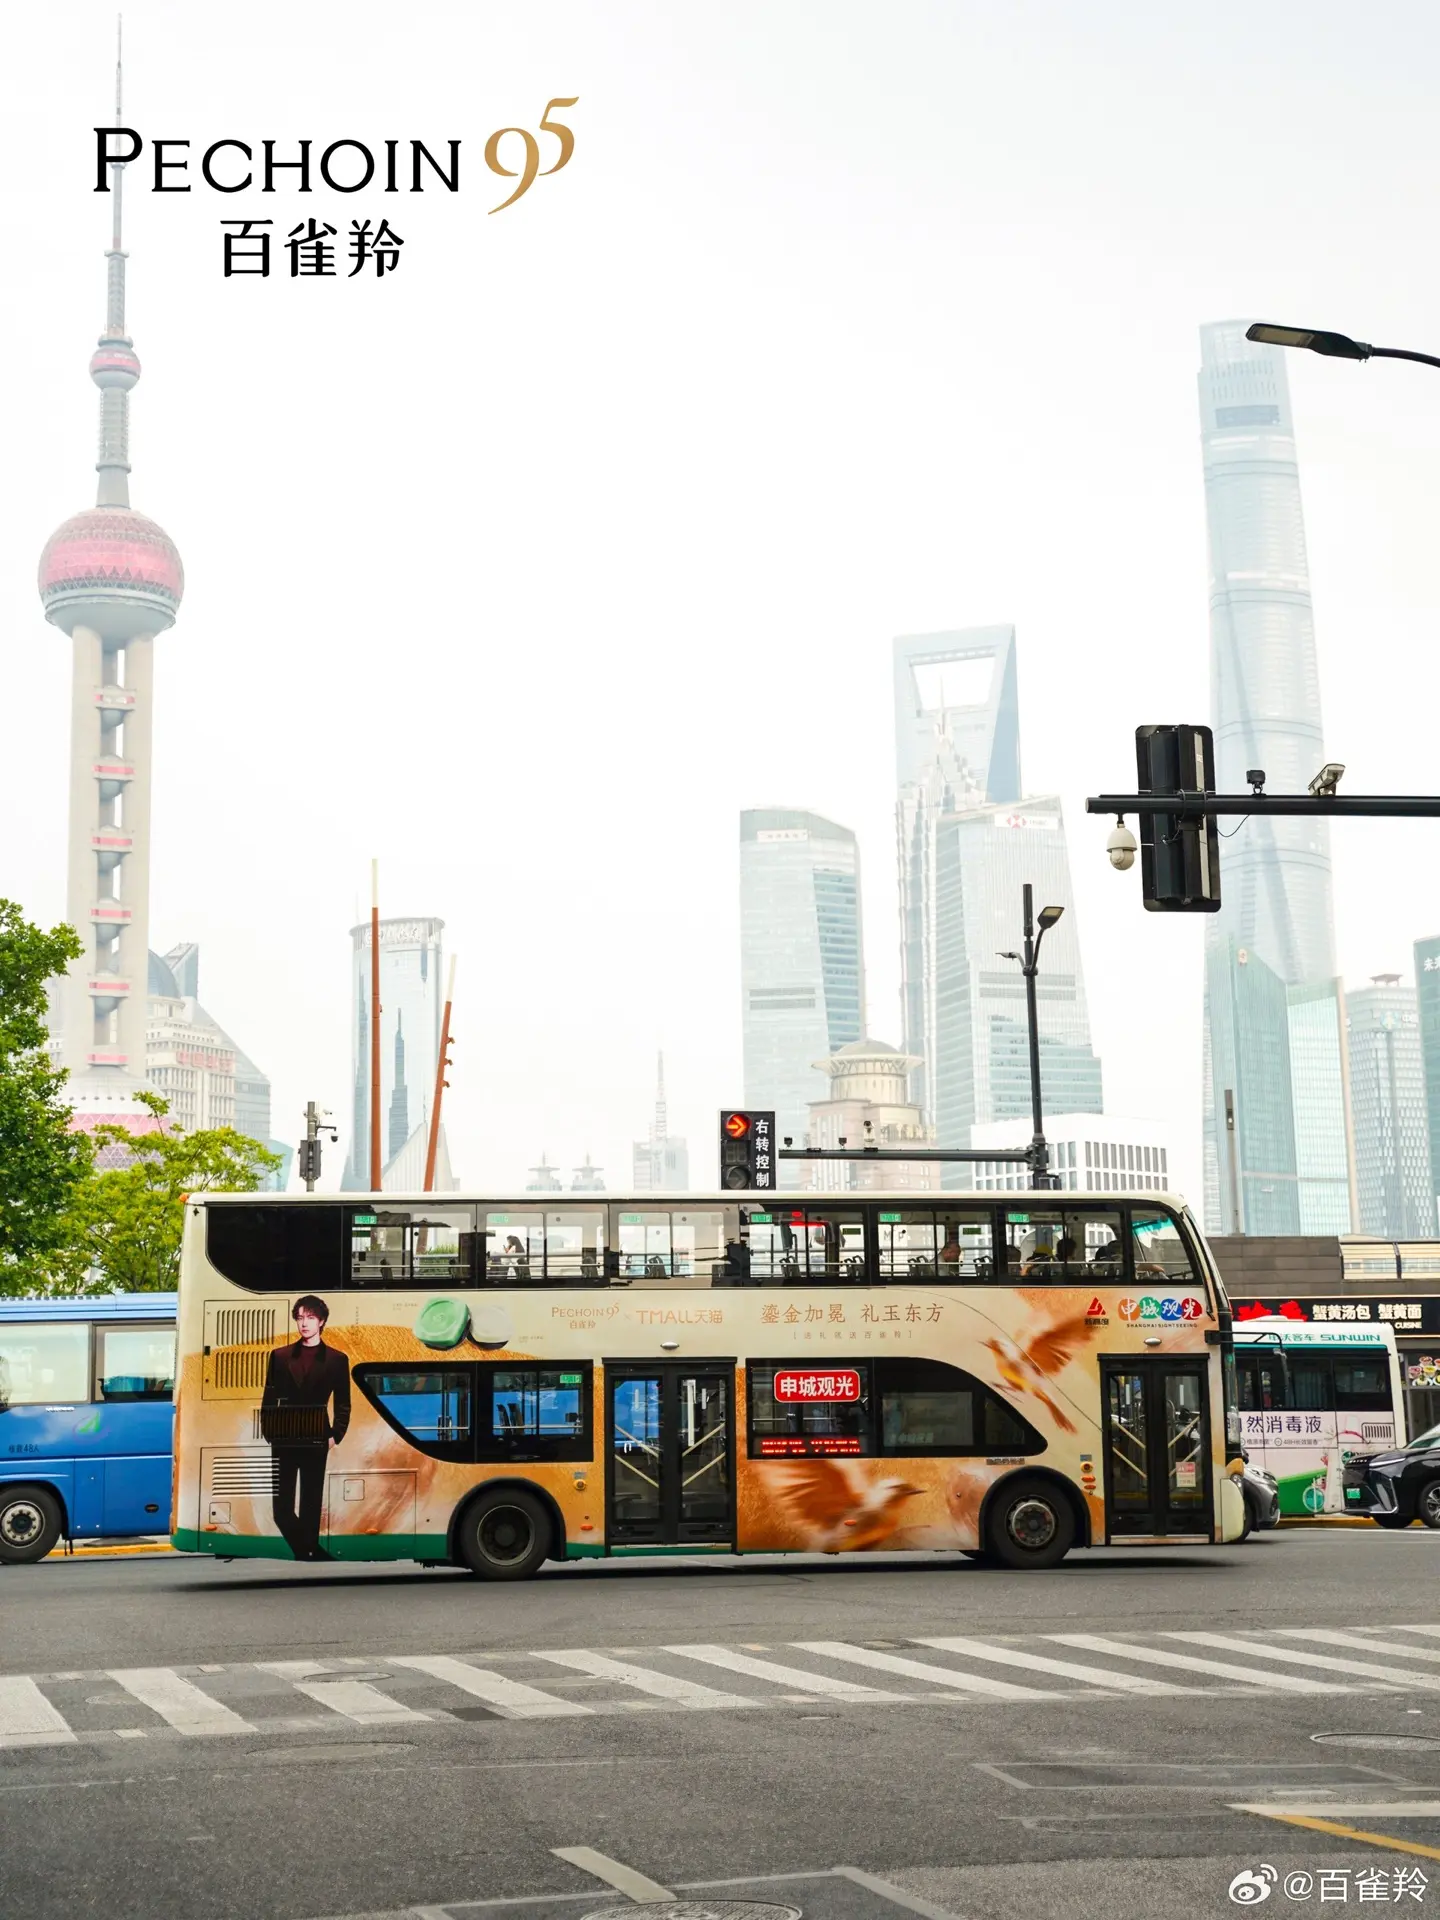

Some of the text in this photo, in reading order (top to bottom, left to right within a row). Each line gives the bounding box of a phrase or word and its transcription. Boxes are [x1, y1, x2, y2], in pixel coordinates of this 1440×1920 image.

[755, 1119, 769, 1187] 右转控制
[552, 1303, 619, 1320] PECHOIN 95
[761, 1303, 944, 1324] 鎏金加冕 礼玉东方
[1119, 1297, 1203, 1321] 申城观光
[1312, 1304, 1371, 1320] 蟹黄汤包
[1378, 1303, 1422, 1320] 蟹黄面
[569, 1320, 596, 1329] 百雀羚
[1320, 1334, 1381, 1342] SUNWIN
[780, 1376, 854, 1398] 申城观光
